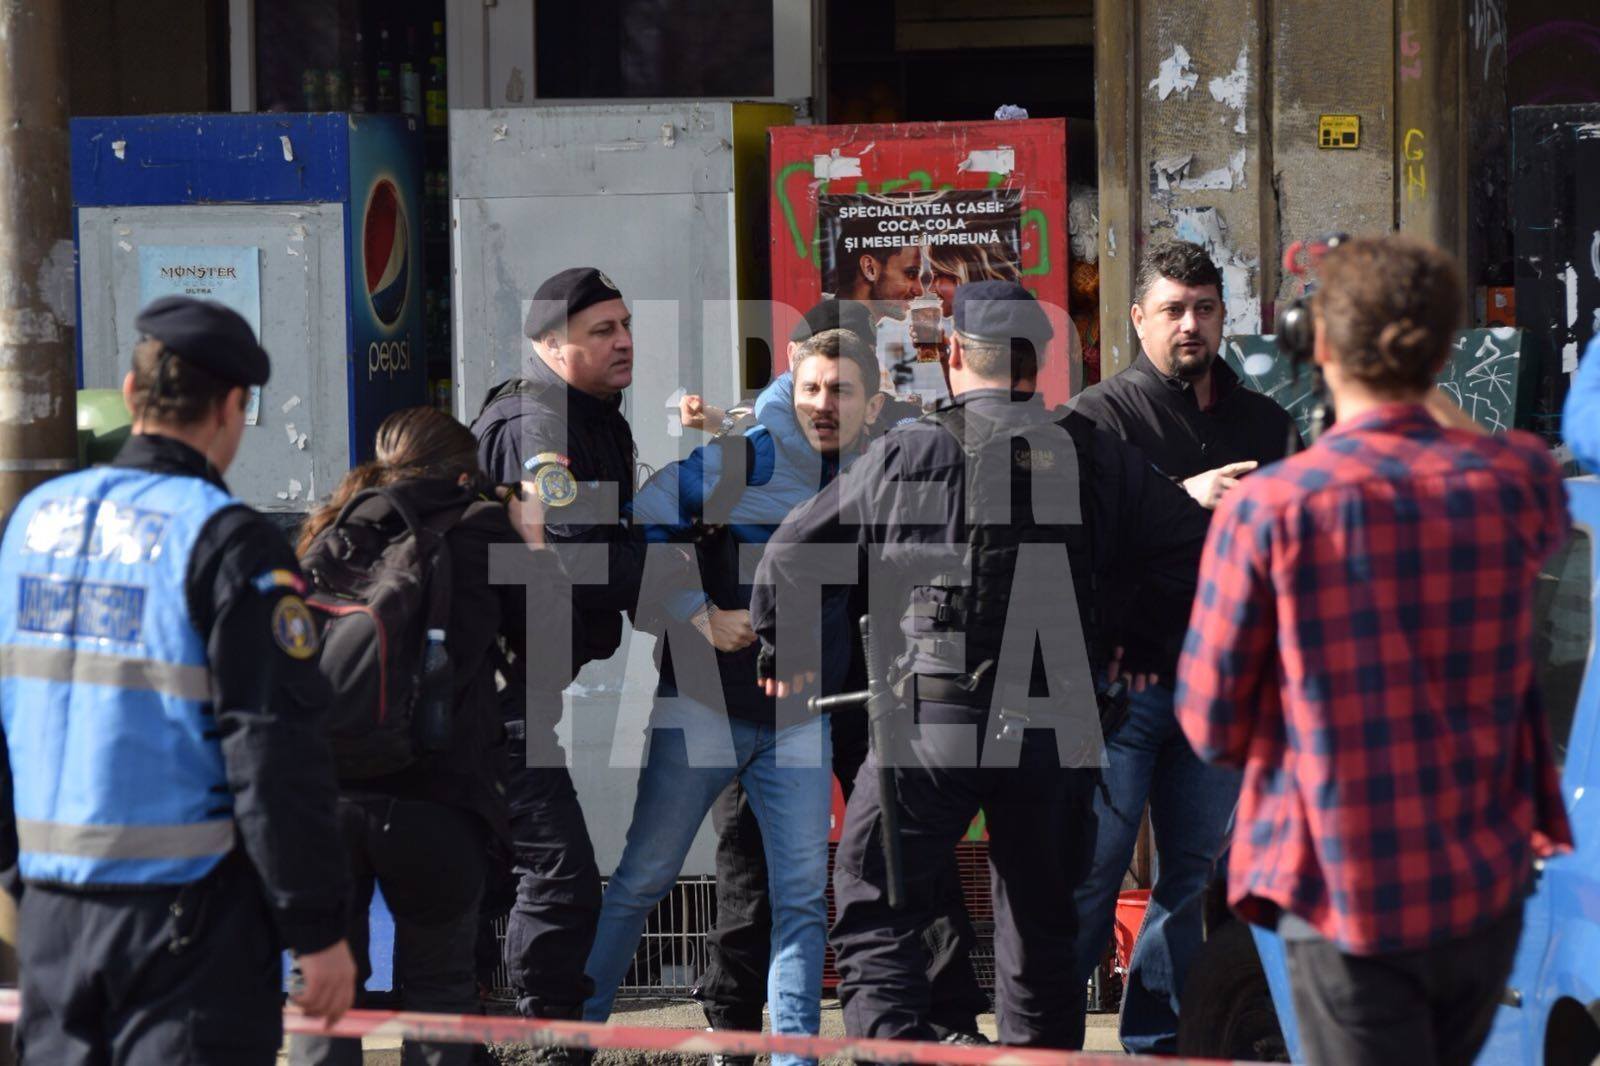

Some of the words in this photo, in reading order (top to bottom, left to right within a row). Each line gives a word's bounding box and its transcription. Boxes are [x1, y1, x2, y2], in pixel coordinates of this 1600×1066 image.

[838, 202, 952, 219] SPECIALITATEA
[955, 201, 1004, 215] CASEI:
[877, 219, 966, 232] COCA-COLA
[861, 235, 920, 249] MESELE
[922, 229, 1000, 246] ÎMPREUNĂ
[160, 265, 237, 279] MONSTER
[185, 287, 212, 295] ULTRA
[368, 332, 410, 382] pepsi
